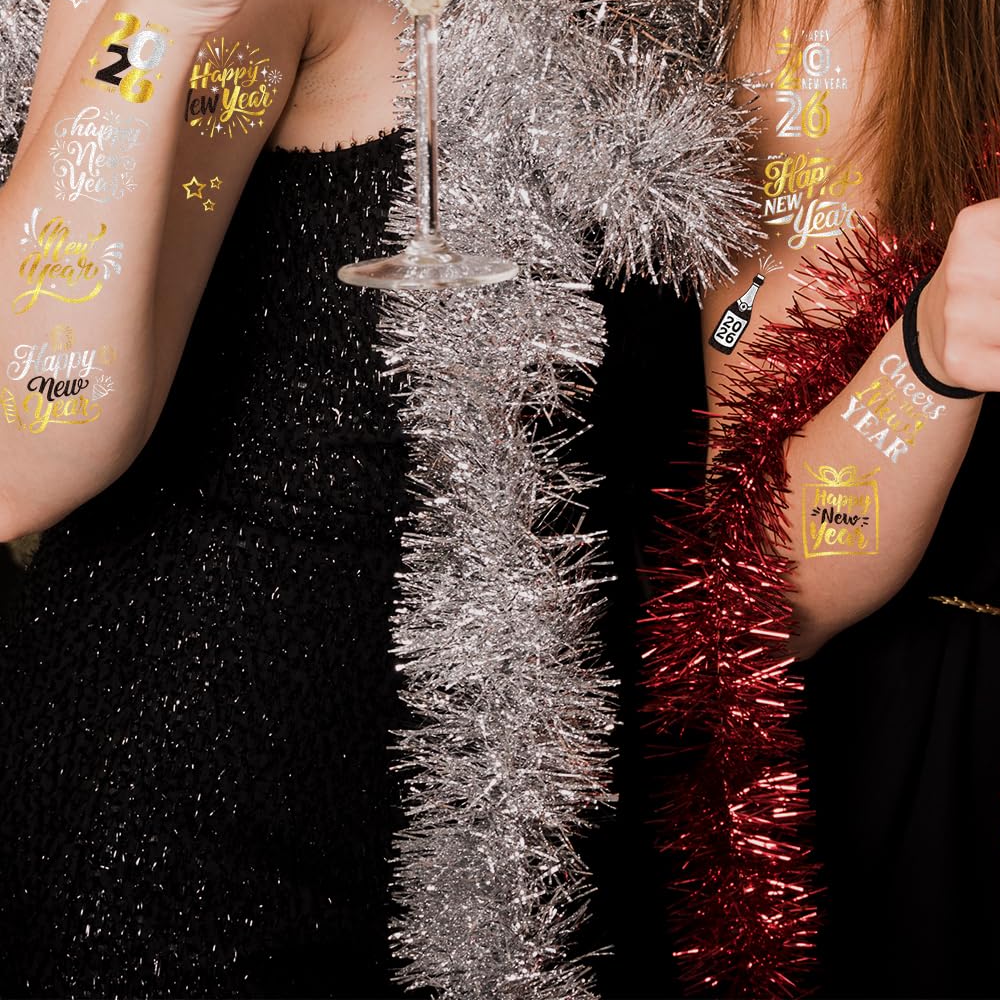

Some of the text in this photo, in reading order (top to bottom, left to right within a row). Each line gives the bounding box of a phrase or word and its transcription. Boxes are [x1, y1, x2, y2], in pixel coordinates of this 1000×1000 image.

[189, 59, 268, 89] Happy
[801, 77, 848, 90] NEW YEAR
[219, 84, 273, 124] Year
[775, 90, 831, 139] 26
[38, 216, 107, 262] New
[764, 192, 857, 250] NEW Year
[12, 251, 103, 315] Year
[716, 327, 736, 344] 26
[723, 315, 742, 333] 20
[6, 343, 103, 382] Happy
[27, 376, 89, 401] New
[879, 354, 946, 420] Cheers
[23, 392, 102, 434] Year
[840, 394, 908, 463] YEAR
[814, 488, 872, 516] Happy
[821, 506, 861, 526] New
